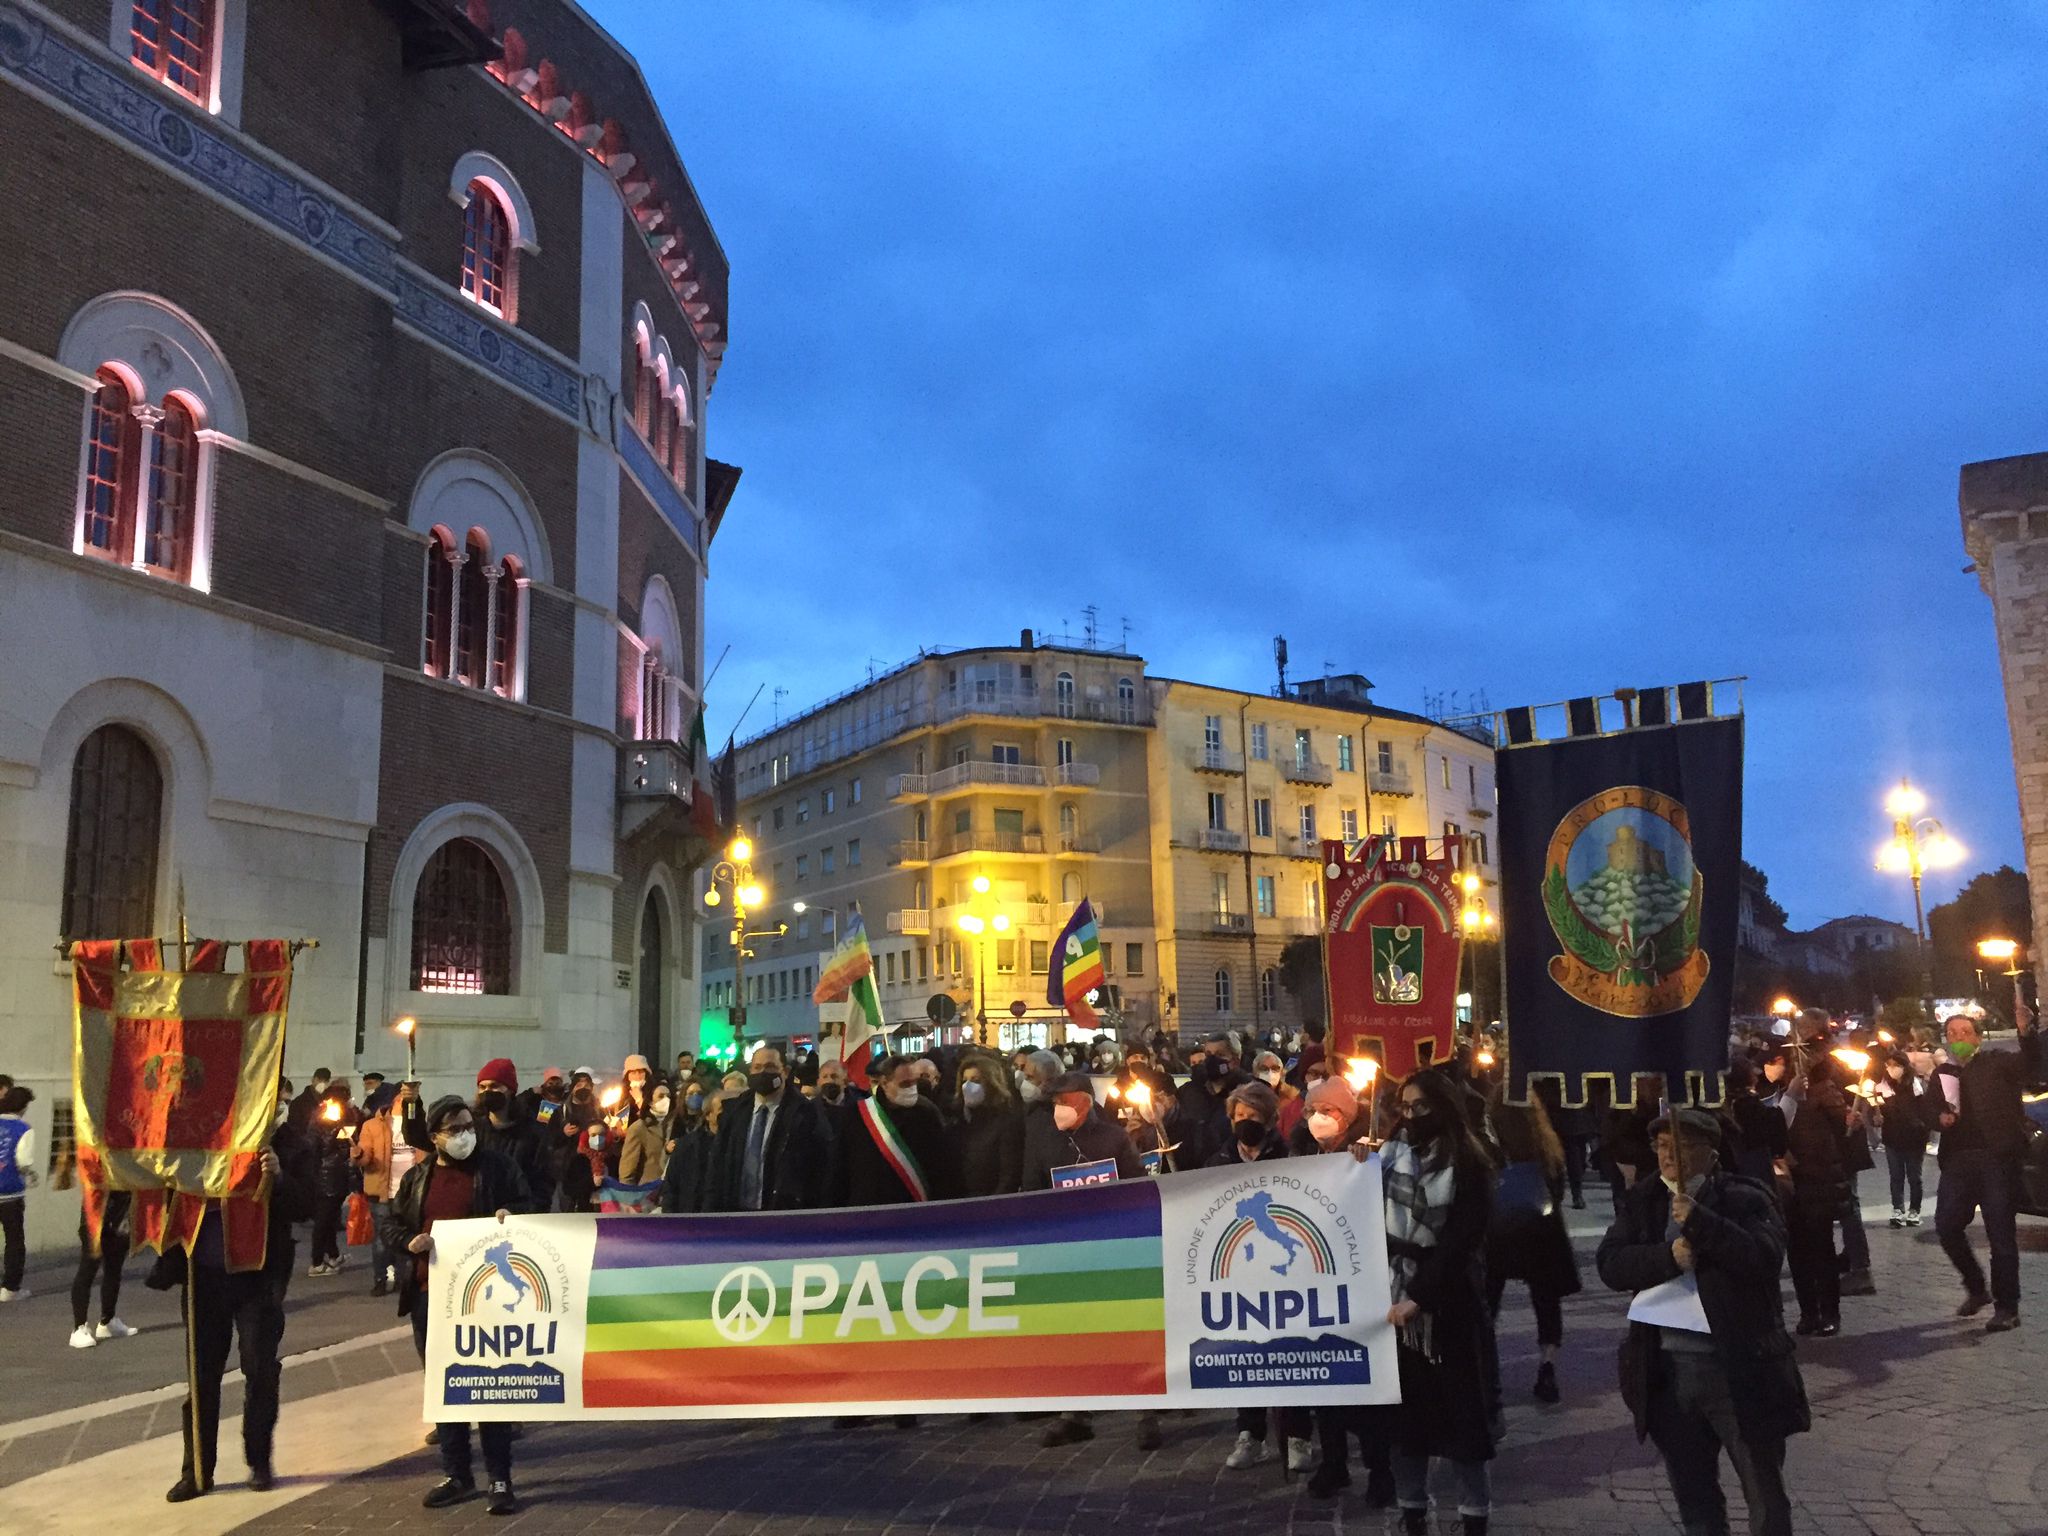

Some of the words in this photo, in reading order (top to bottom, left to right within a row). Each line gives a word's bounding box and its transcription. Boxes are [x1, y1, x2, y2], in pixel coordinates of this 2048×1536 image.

[1187, 1228, 1205, 1285] UNIONE
[1200, 1176, 1268, 1228] NAZIONALE
[1272, 1176, 1301, 1190] PRO
[1303, 1184, 1338, 1215] LOCO
[1335, 1215, 1362, 1276] D'ITALIA
[446, 1272, 458, 1319] UNIONE
[456, 1228, 513, 1269] NAZIONALE
[515, 1228, 536, 1241] PRO
[537, 1236, 561, 1262] LOCO
[556, 1263, 569, 1314] D'ITALIA
[788, 1252, 1019, 1339] PACE
[1201, 1284, 1350, 1331] UNPLI
[455, 1320, 558, 1358] UNPLI
[1194, 1353, 1264, 1367] COMITATO
[1268, 1349, 1363, 1365] PROVINCIALE
[448, 1376, 497, 1388] COMITATO
[498, 1375, 561, 1387] PROVINCIALE
[1228, 1370, 1243, 1382] DI
[1246, 1367, 1330, 1382] BENEVENTO
[470, 1389, 481, 1400] DI
[483, 1388, 538, 1400] BENEVENTO
